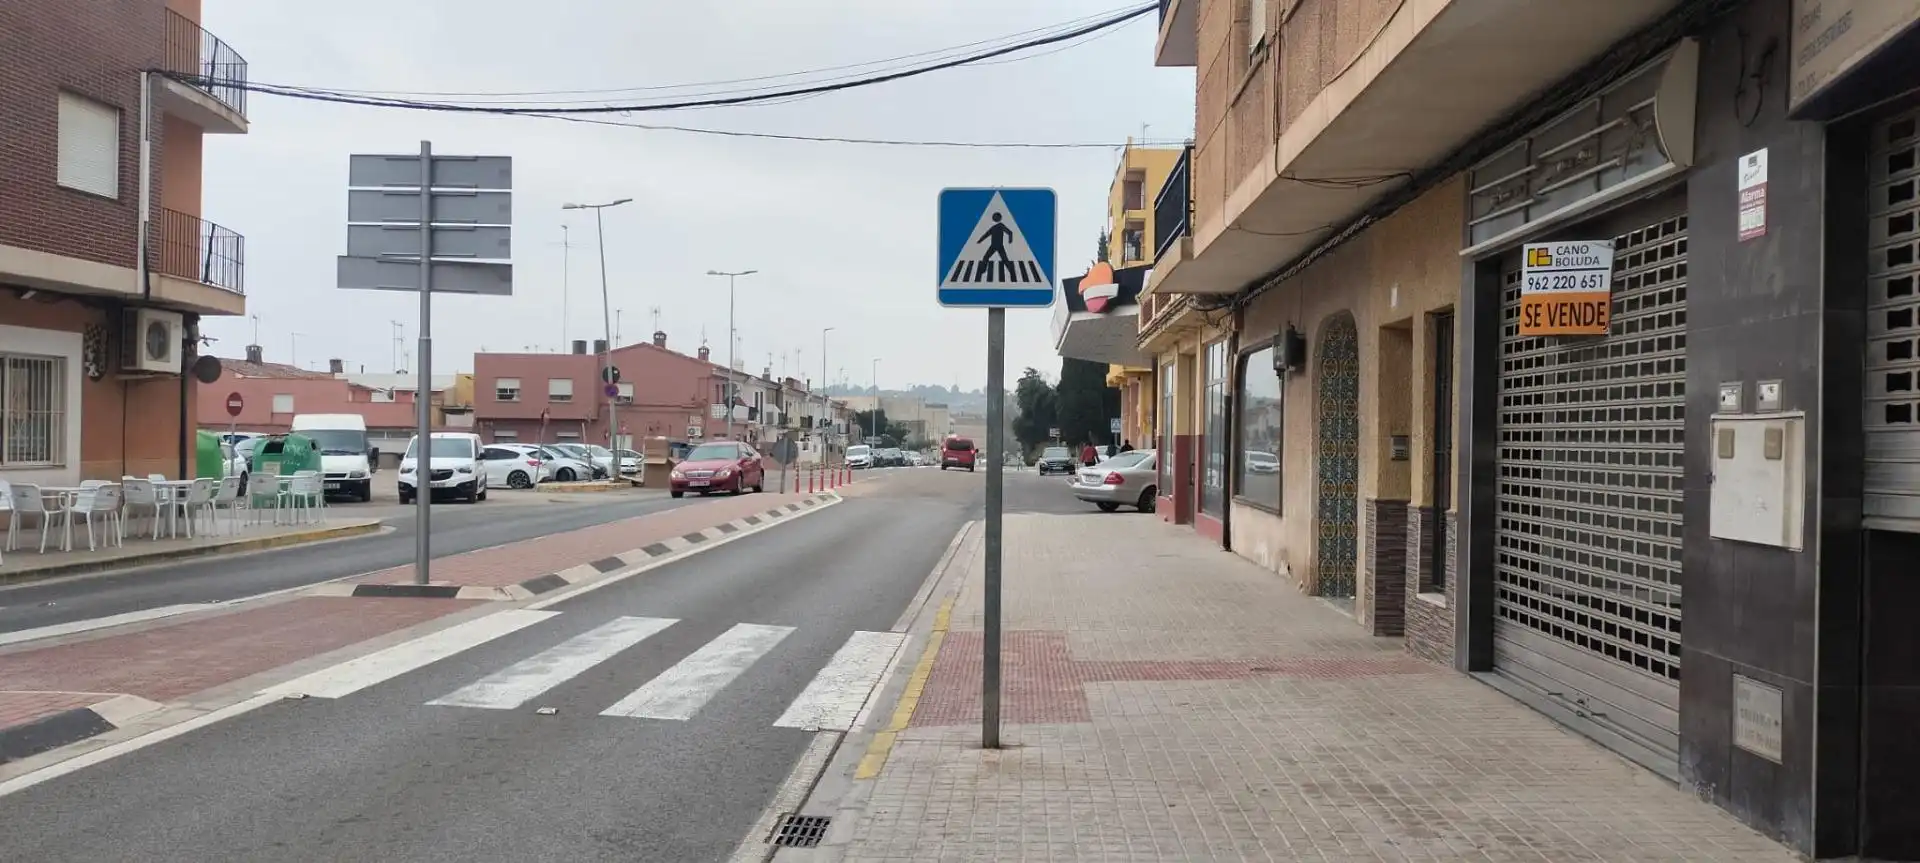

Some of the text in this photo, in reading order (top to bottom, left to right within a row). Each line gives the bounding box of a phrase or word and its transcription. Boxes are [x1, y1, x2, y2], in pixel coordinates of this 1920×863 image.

[1556, 245, 1589, 256] CANO
[1555, 256, 1600, 267] BOLUDA
[1528, 274, 1603, 290] 962 220 651
[1524, 302, 1606, 328] SE VENDE
